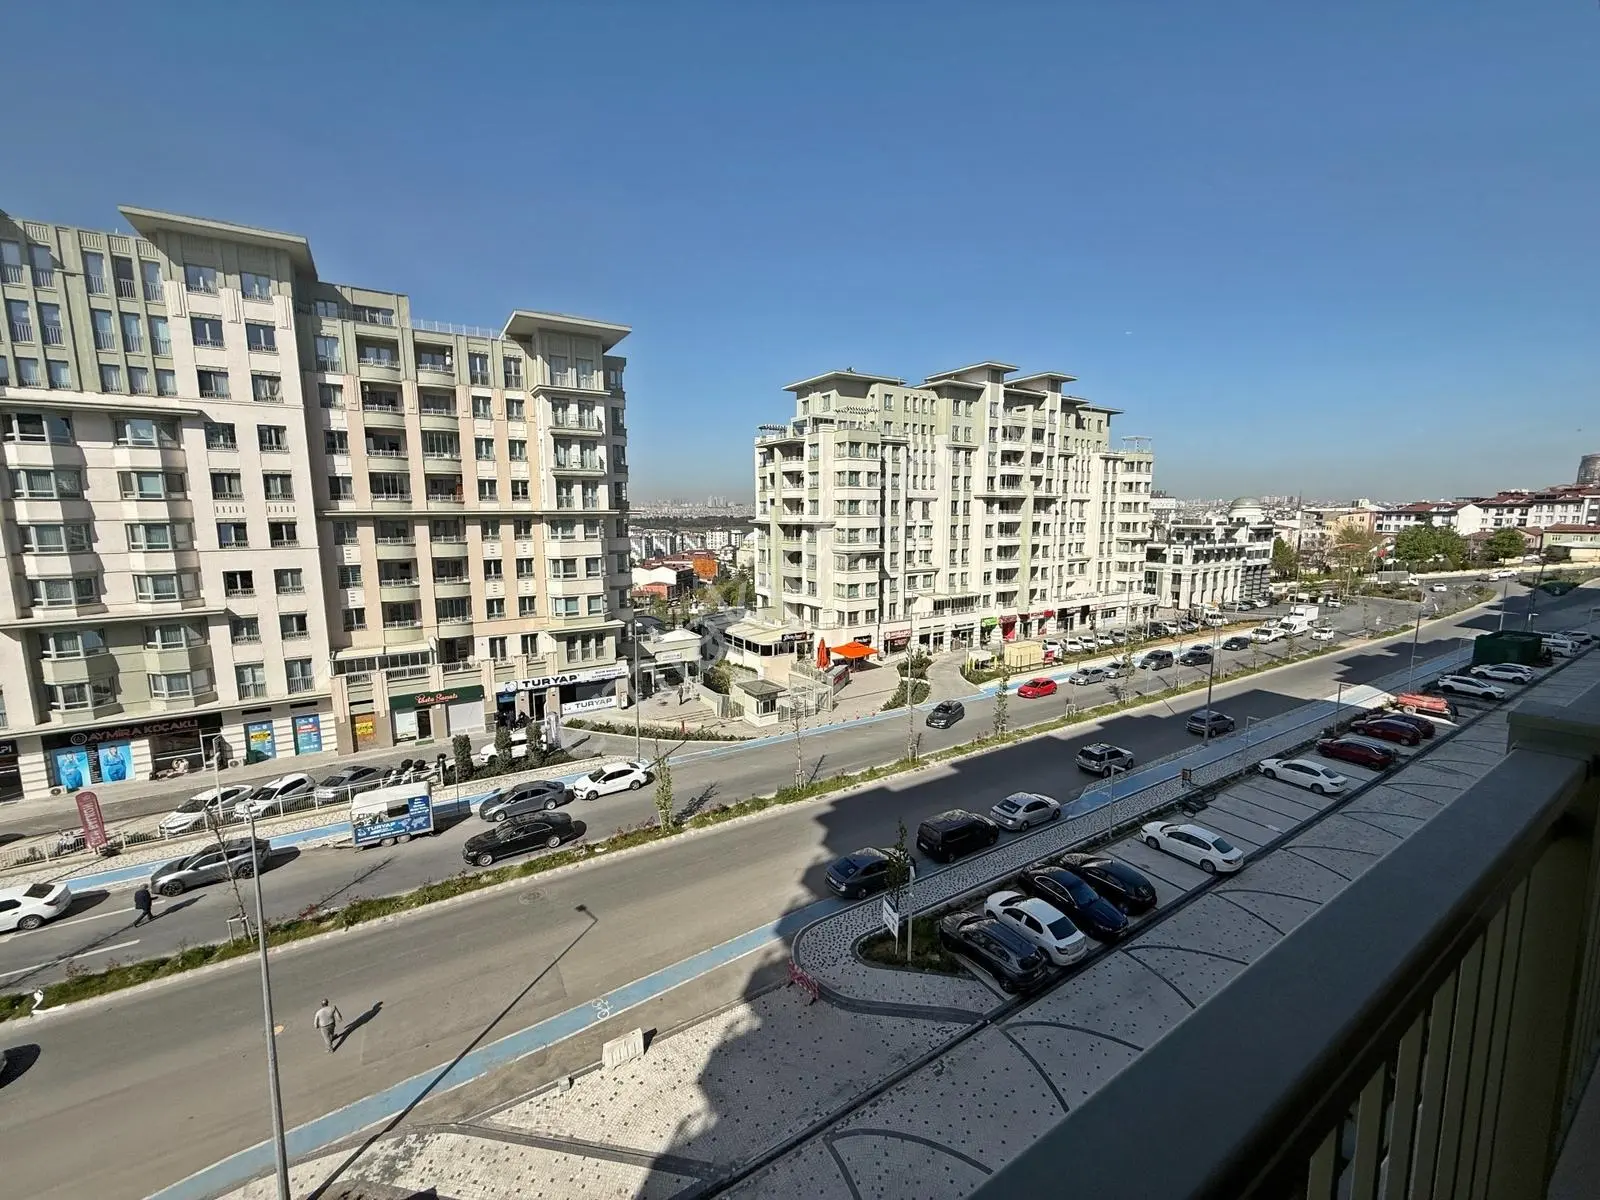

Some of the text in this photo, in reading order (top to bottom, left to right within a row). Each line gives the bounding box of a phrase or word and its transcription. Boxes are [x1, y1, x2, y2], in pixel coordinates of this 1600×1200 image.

[522, 674, 577, 688] TURYAP
[575, 698, 613, 709] TURYAP
[366, 821, 396, 831] TURYAP
